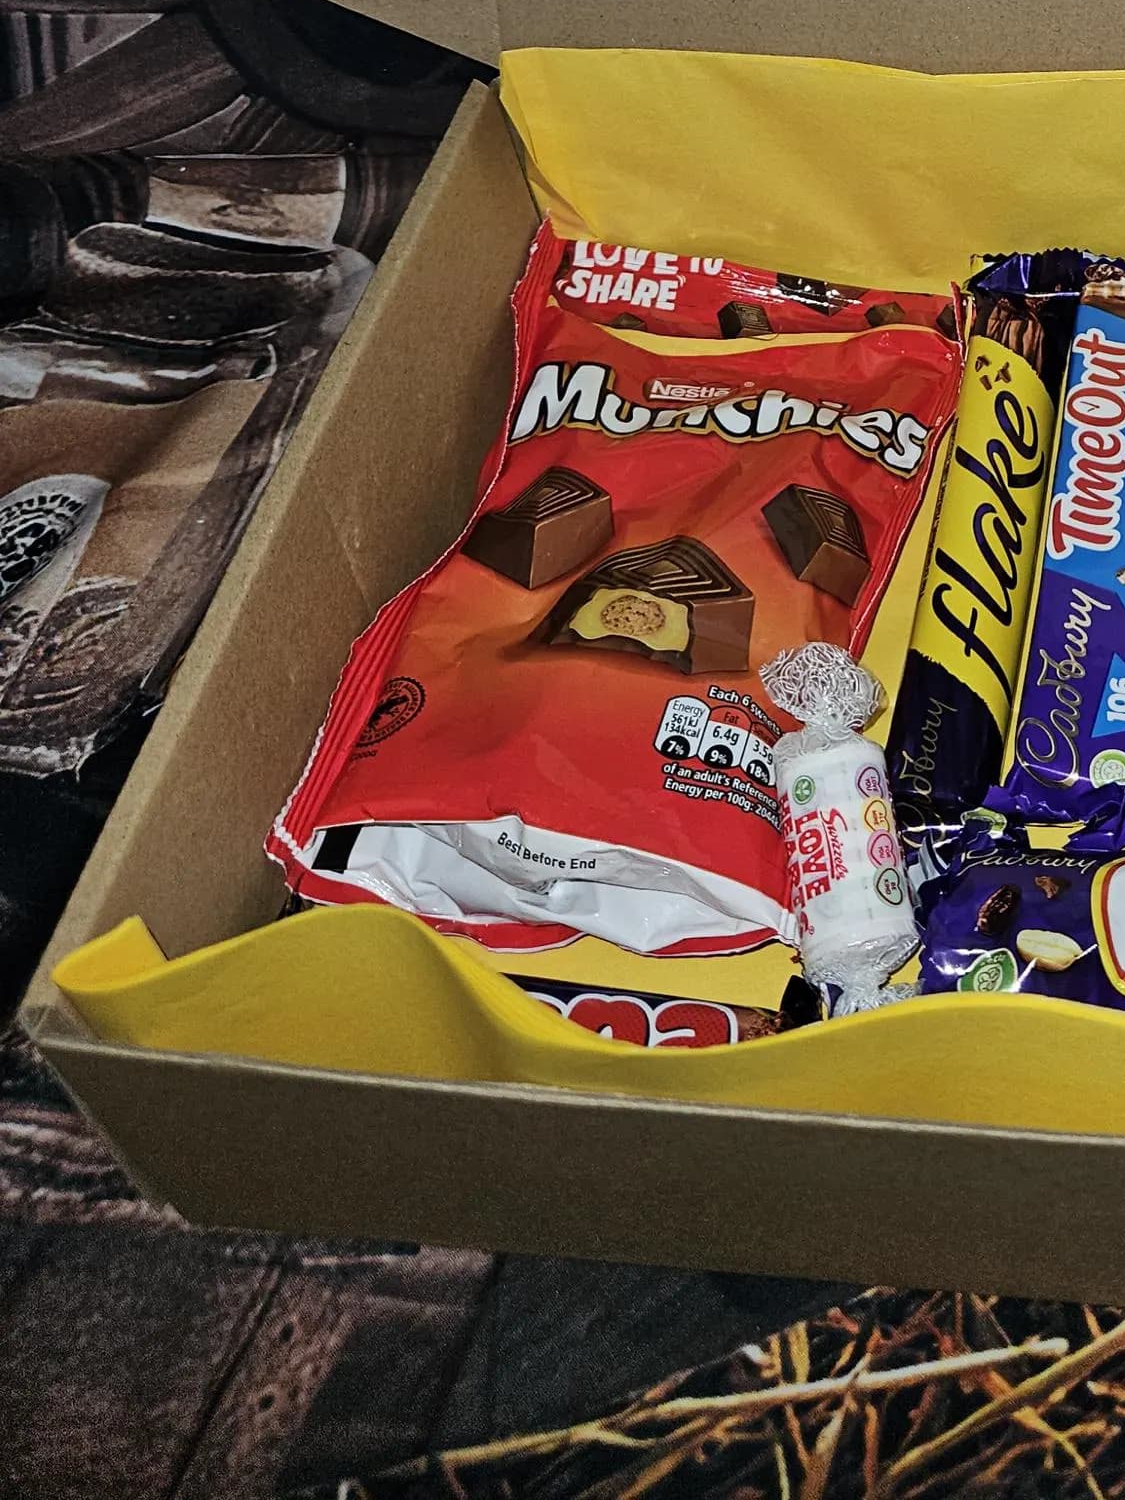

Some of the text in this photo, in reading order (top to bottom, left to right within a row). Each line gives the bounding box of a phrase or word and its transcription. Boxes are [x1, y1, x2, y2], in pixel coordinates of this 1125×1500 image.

[564, 269, 679, 311] SHARE
[510, 362, 930, 471] Munchies
[930, 389, 1046, 702] flake
[709, 687, 739, 703] Each
[742, 695, 751, 706] 6
[1014, 587, 1112, 788] Cadbury
[672, 701, 706, 717] Energy
[724, 712, 740, 724] Fat
[665, 722, 700, 738] 134kcal
[712, 725, 740, 745] 6.4g
[666, 740, 685, 755] 7%
[709, 750, 728, 764] 9%
[752, 739, 774, 766] 3.5g
[663, 763, 778, 809] of an adult's Reference
[749, 763, 769, 784] 18%
[665, 778, 704, 798] Energy
[704, 787, 724, 801] per
[727, 791, 755, 812] 100g:
[497, 831, 596, 869] Best Before End
[795, 810, 832, 900] LOVE
[957, 848, 1097, 877] Cadbury
